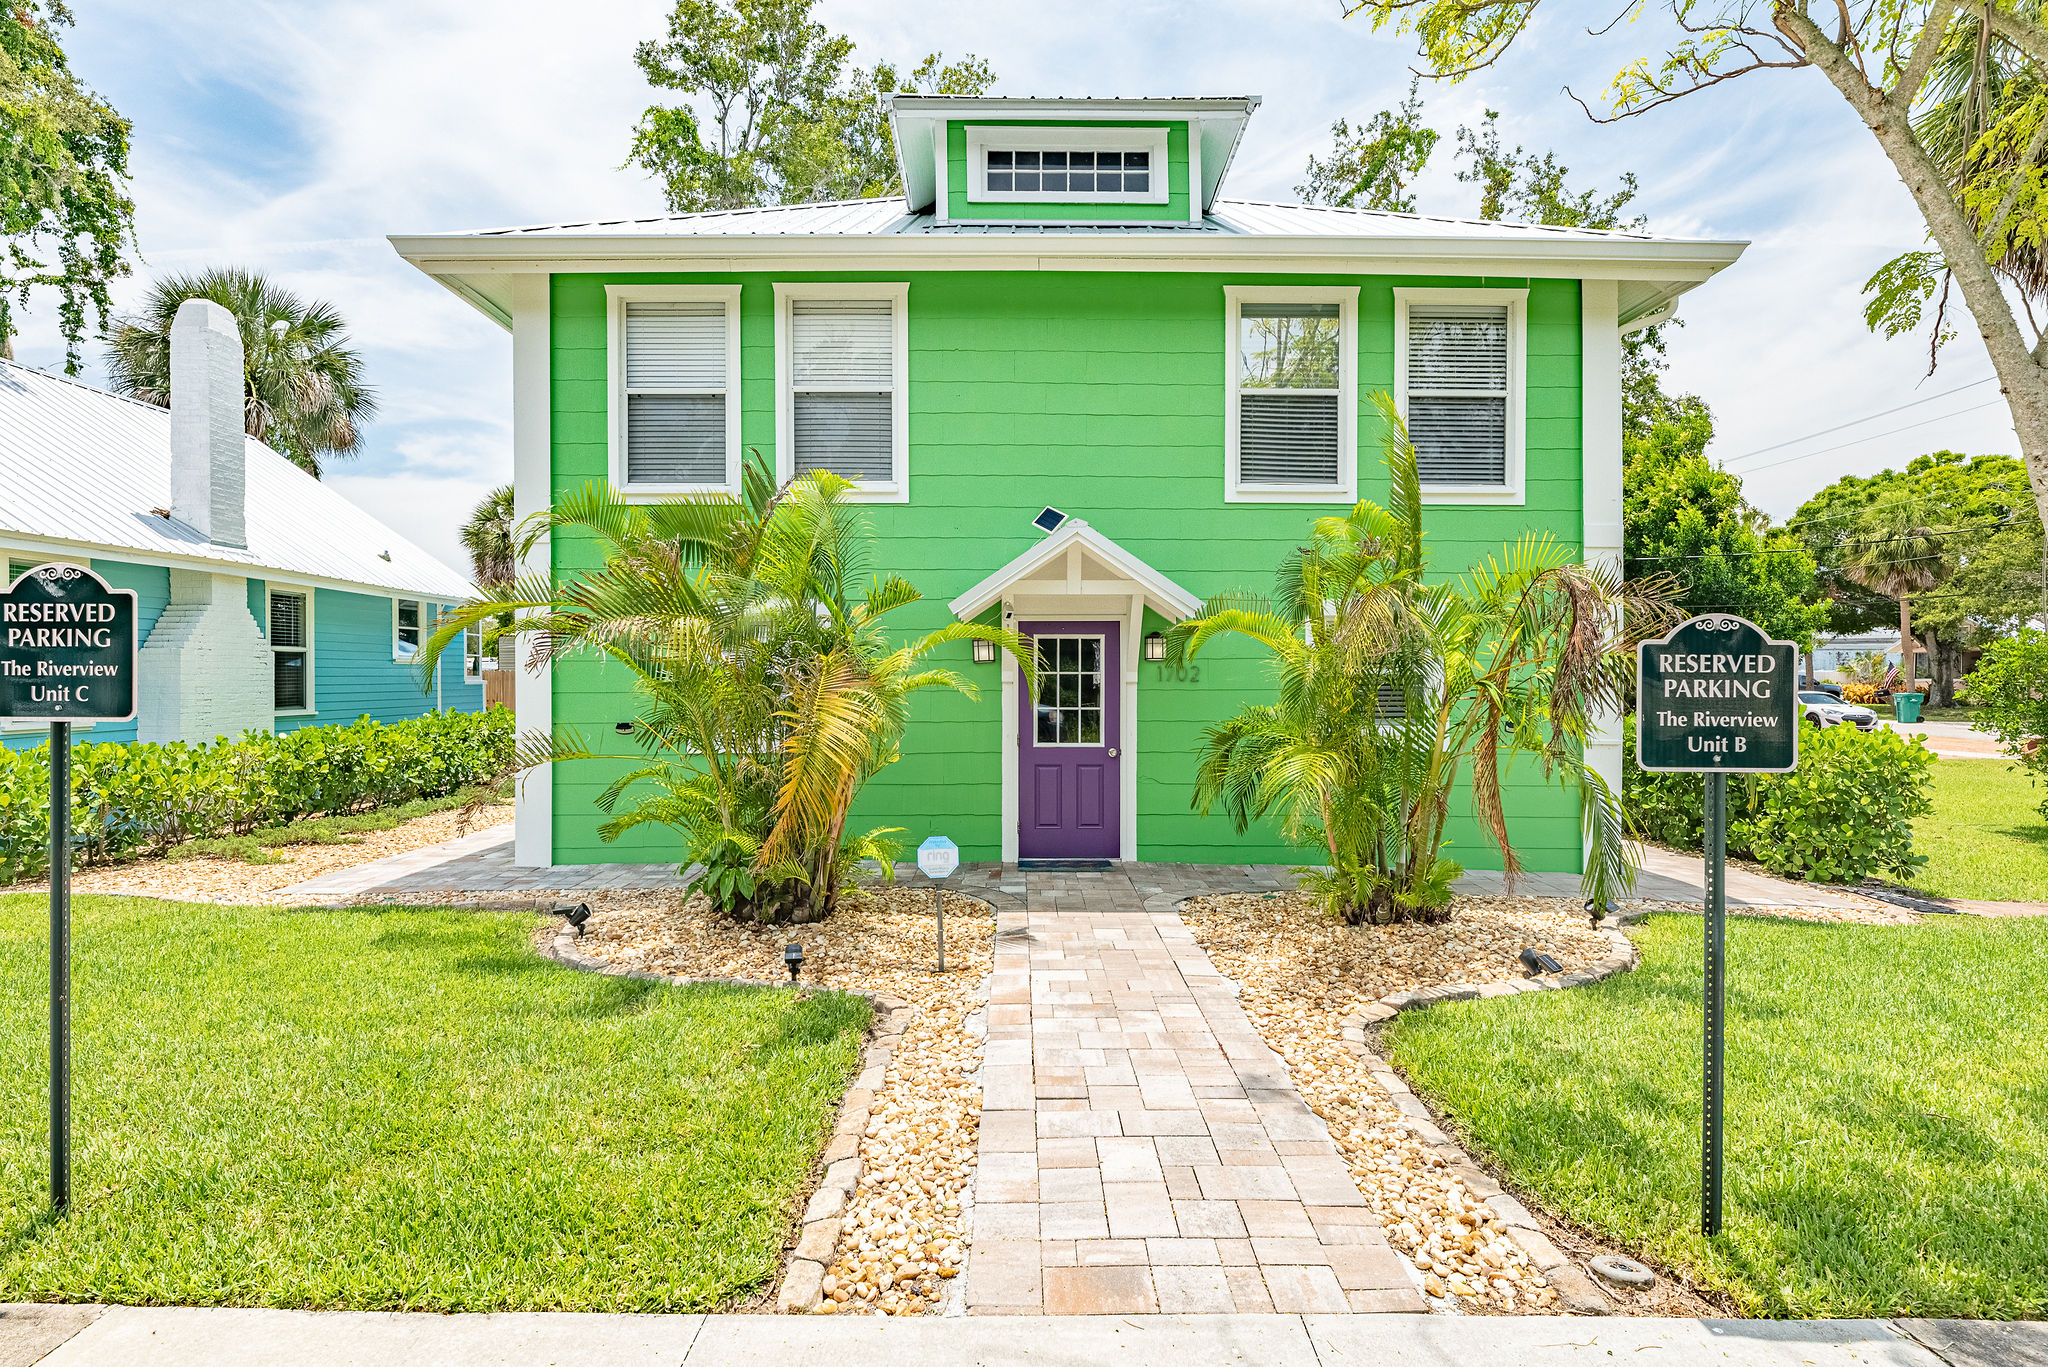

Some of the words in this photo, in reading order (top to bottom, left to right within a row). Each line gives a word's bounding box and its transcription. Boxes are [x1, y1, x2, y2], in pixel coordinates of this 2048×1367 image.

[3, 603, 116, 622] RESERVED
[8, 628, 111, 648] PARKING
[1, 660, 31, 676] The
[37, 660, 119, 676] Riverview
[1659, 654, 1776, 674] RESERVED
[30, 684, 70, 702] Unit
[75, 686, 89, 702] C
[1664, 679, 1771, 699] PARKING
[1656, 711, 1688, 727] The
[1693, 711, 1779, 727] Riverview
[1688, 735, 1729, 753] Unit
[1734, 736, 1747, 753] B
[927, 849, 950, 862] ring
